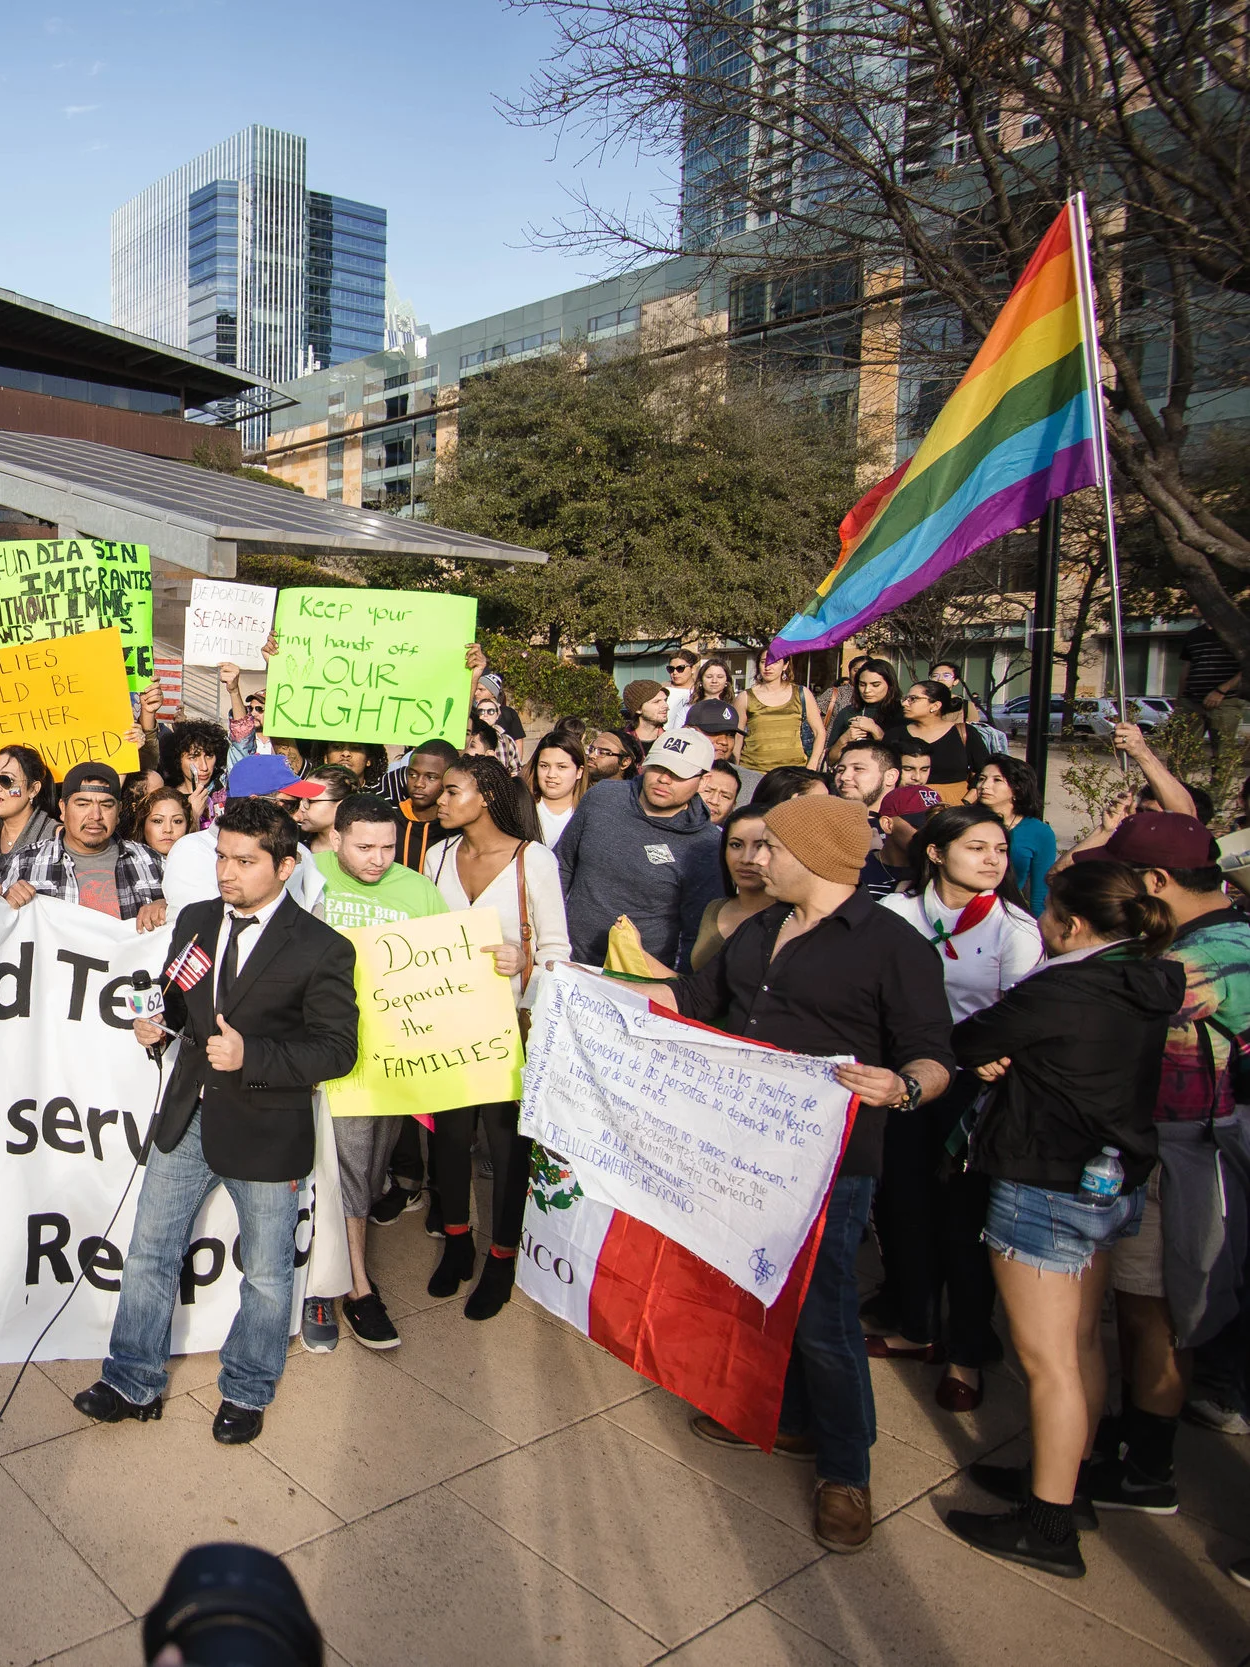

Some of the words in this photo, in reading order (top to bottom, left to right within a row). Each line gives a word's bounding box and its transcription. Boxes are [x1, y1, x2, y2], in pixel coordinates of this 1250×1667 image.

[37, 541, 83, 566] DIA
[91, 539, 138, 563] SIN
[20, 566, 152, 596] IMIGRANTES
[193, 583, 265, 607] DEPORTING
[193, 608, 266, 633] SEPARATES
[368, 607, 413, 626] your
[45, 620, 85, 639] THE
[193, 633, 260, 659] FAMILIES
[274, 627, 311, 655] tiny
[324, 633, 375, 652] hands
[388, 642, 420, 657] off
[322, 655, 400, 688] OUR
[51, 674, 84, 697] BE
[272, 683, 455, 737] RIGHTS!
[662, 737, 692, 754] CAT
[326, 898, 374, 917] EARLY
[374, 905, 409, 921] BIRD
[326, 913, 341, 925] AY
[342, 914, 362, 926] GET
[375, 924, 475, 977] Don't
[147, 991, 162, 1012] 62
[373, 977, 475, 1013] Separate
[400, 1018, 434, 1037] the
[650, 1048, 667, 1064] que
[623, 1076, 636, 1089] su
[629, 1055, 641, 1073] de
[789, 1132, 806, 1148] de
[801, 1095, 817, 1112] de
[750, 1180, 768, 1197] que
